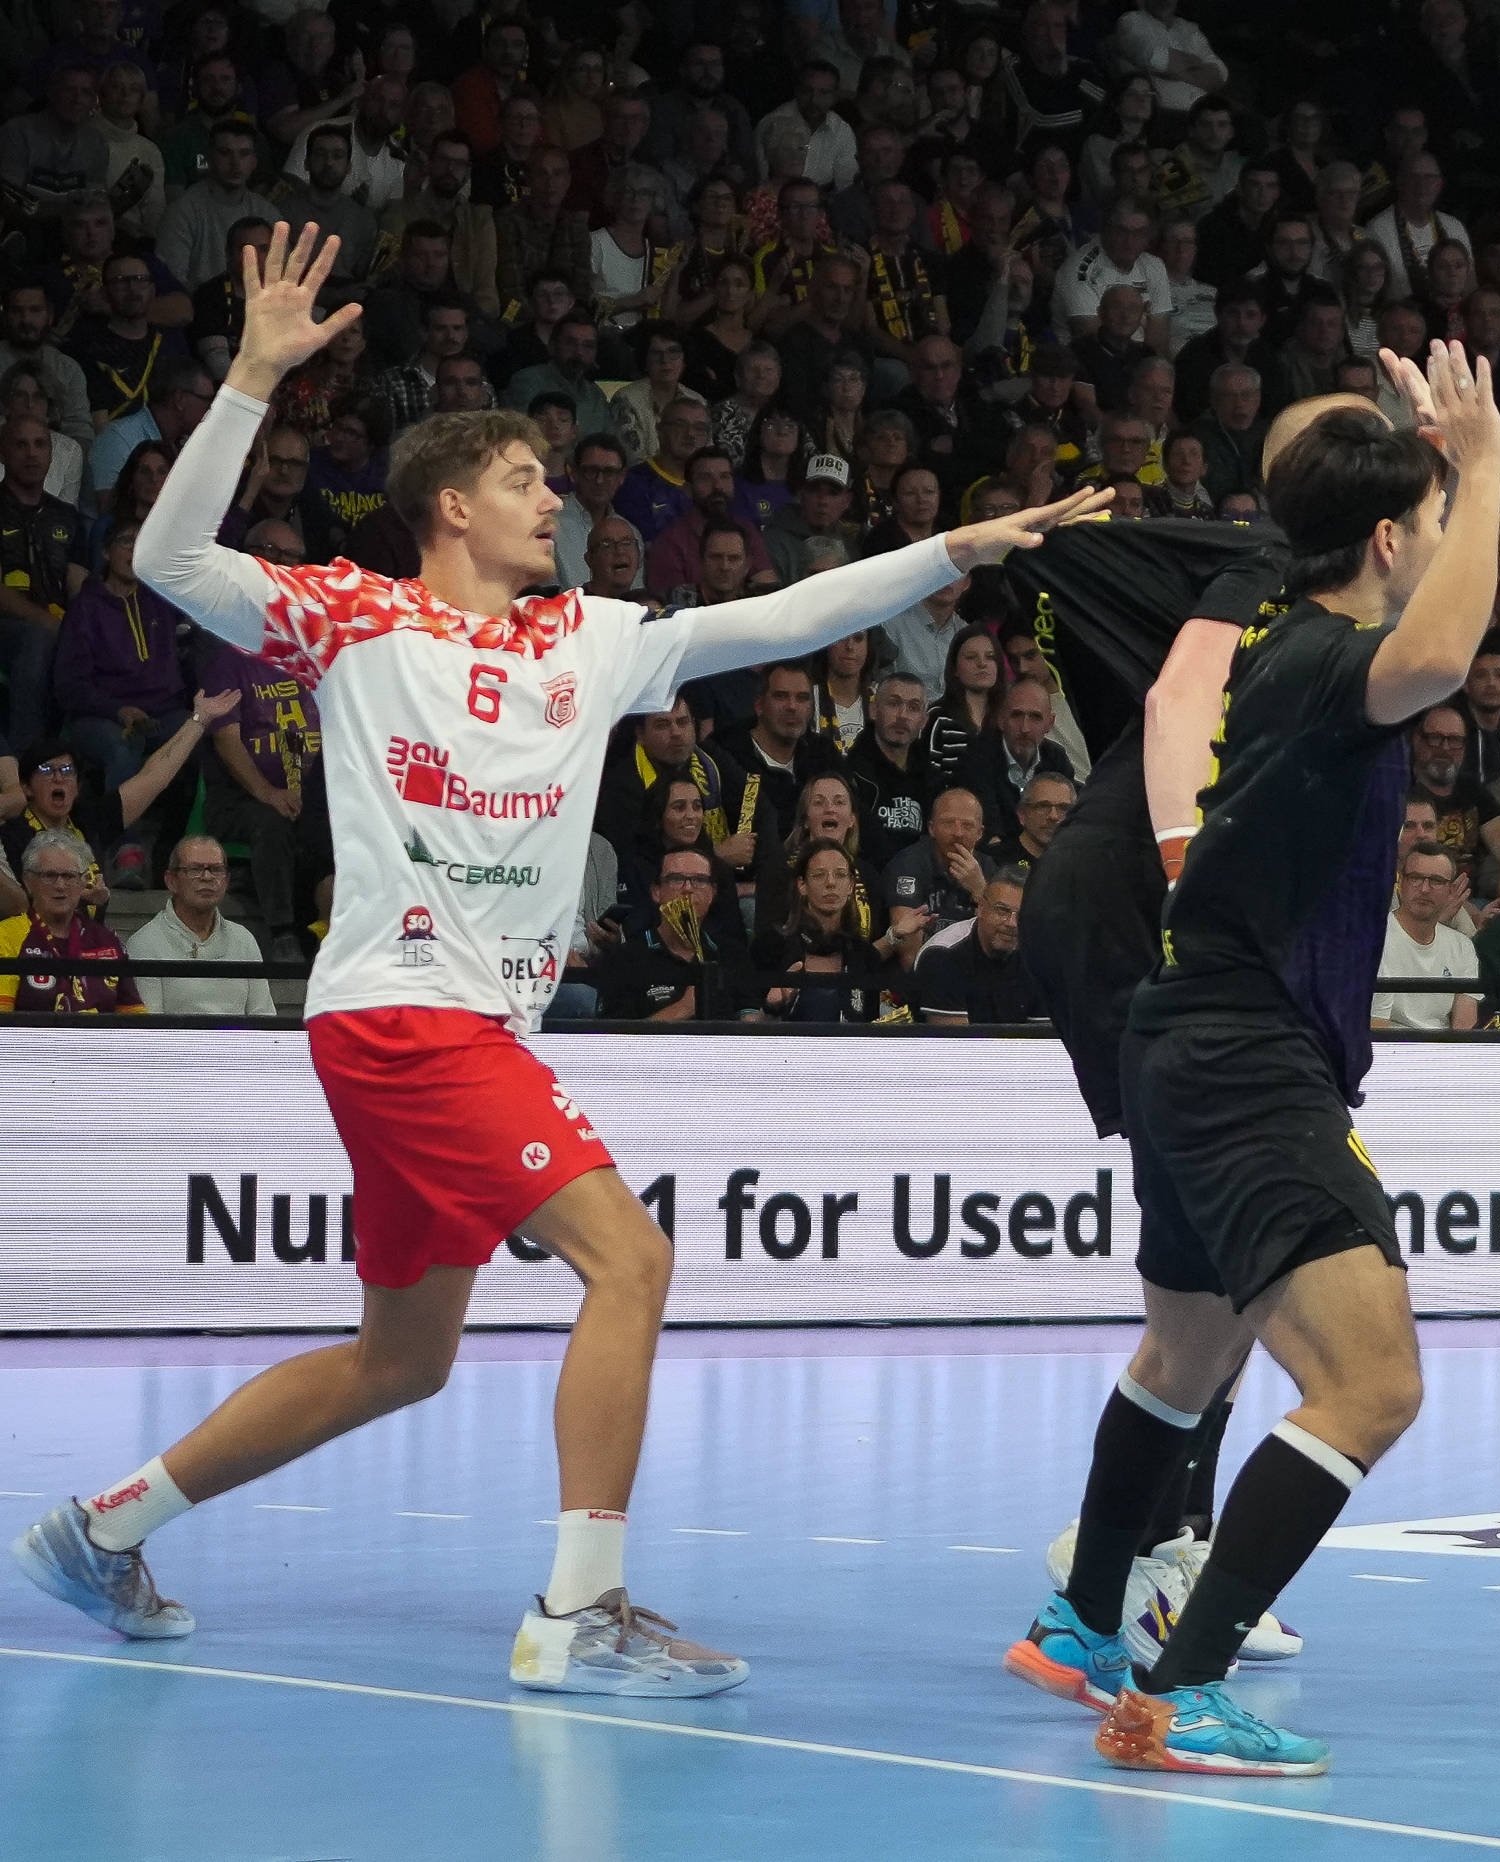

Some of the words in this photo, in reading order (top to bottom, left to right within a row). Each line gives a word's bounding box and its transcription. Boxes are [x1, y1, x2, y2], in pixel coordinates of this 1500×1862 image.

[467, 662, 508, 724] 6
[250, 731, 322, 754] TIE
[445, 771, 565, 820] Baumit
[407, 915, 430, 930] 30
[402, 943, 434, 966] HS
[640, 1173, 677, 1243] 1
[718, 1168, 859, 1260] for
[891, 1168, 1114, 1259] Used
